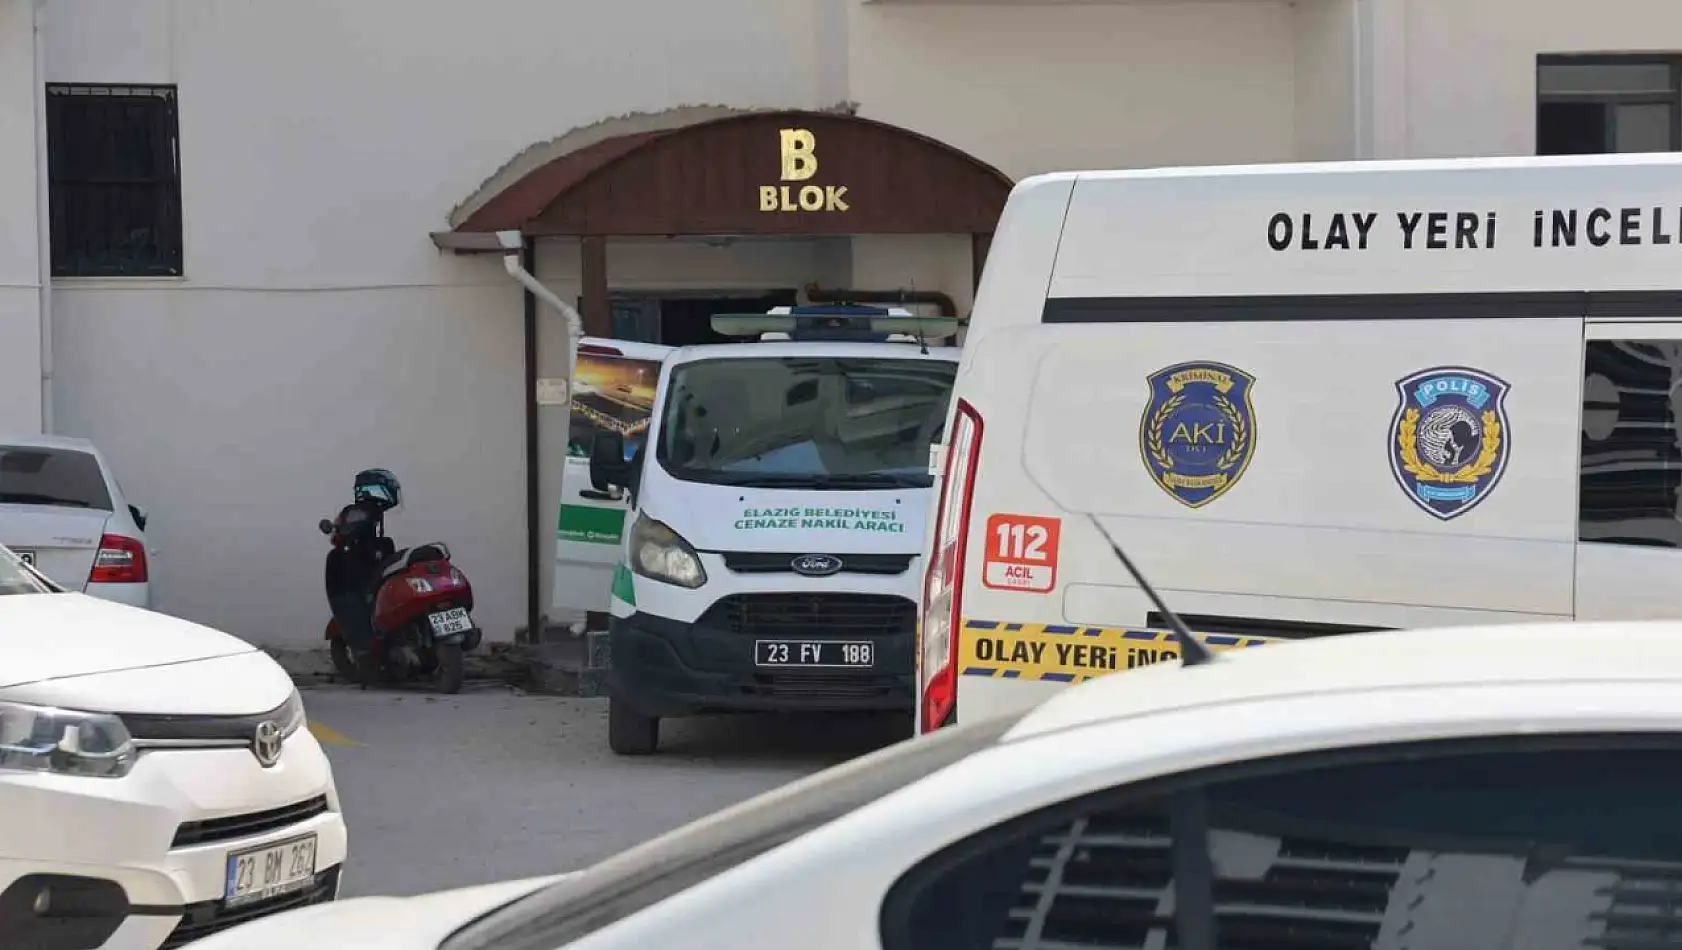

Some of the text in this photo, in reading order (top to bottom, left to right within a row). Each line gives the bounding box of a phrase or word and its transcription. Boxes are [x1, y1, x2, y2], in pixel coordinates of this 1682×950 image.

[780, 129, 818, 181] B
[760, 185, 850, 212] BLOK
[1267, 212, 1378, 252] OLAY
[1533, 206, 1682, 248] İNCEL
[1169, 419, 1226, 444] AKİ
[734, 519, 799, 530] CENAZE
[854, 519, 904, 533] ARACI
[804, 507, 897, 521] BELEDİYESİ
[996, 523, 1048, 560] 112
[768, 643, 870, 663] 23 FV 188
[975, 638, 1046, 664] OLAY
[236, 841, 314, 890] 23 BM 262
